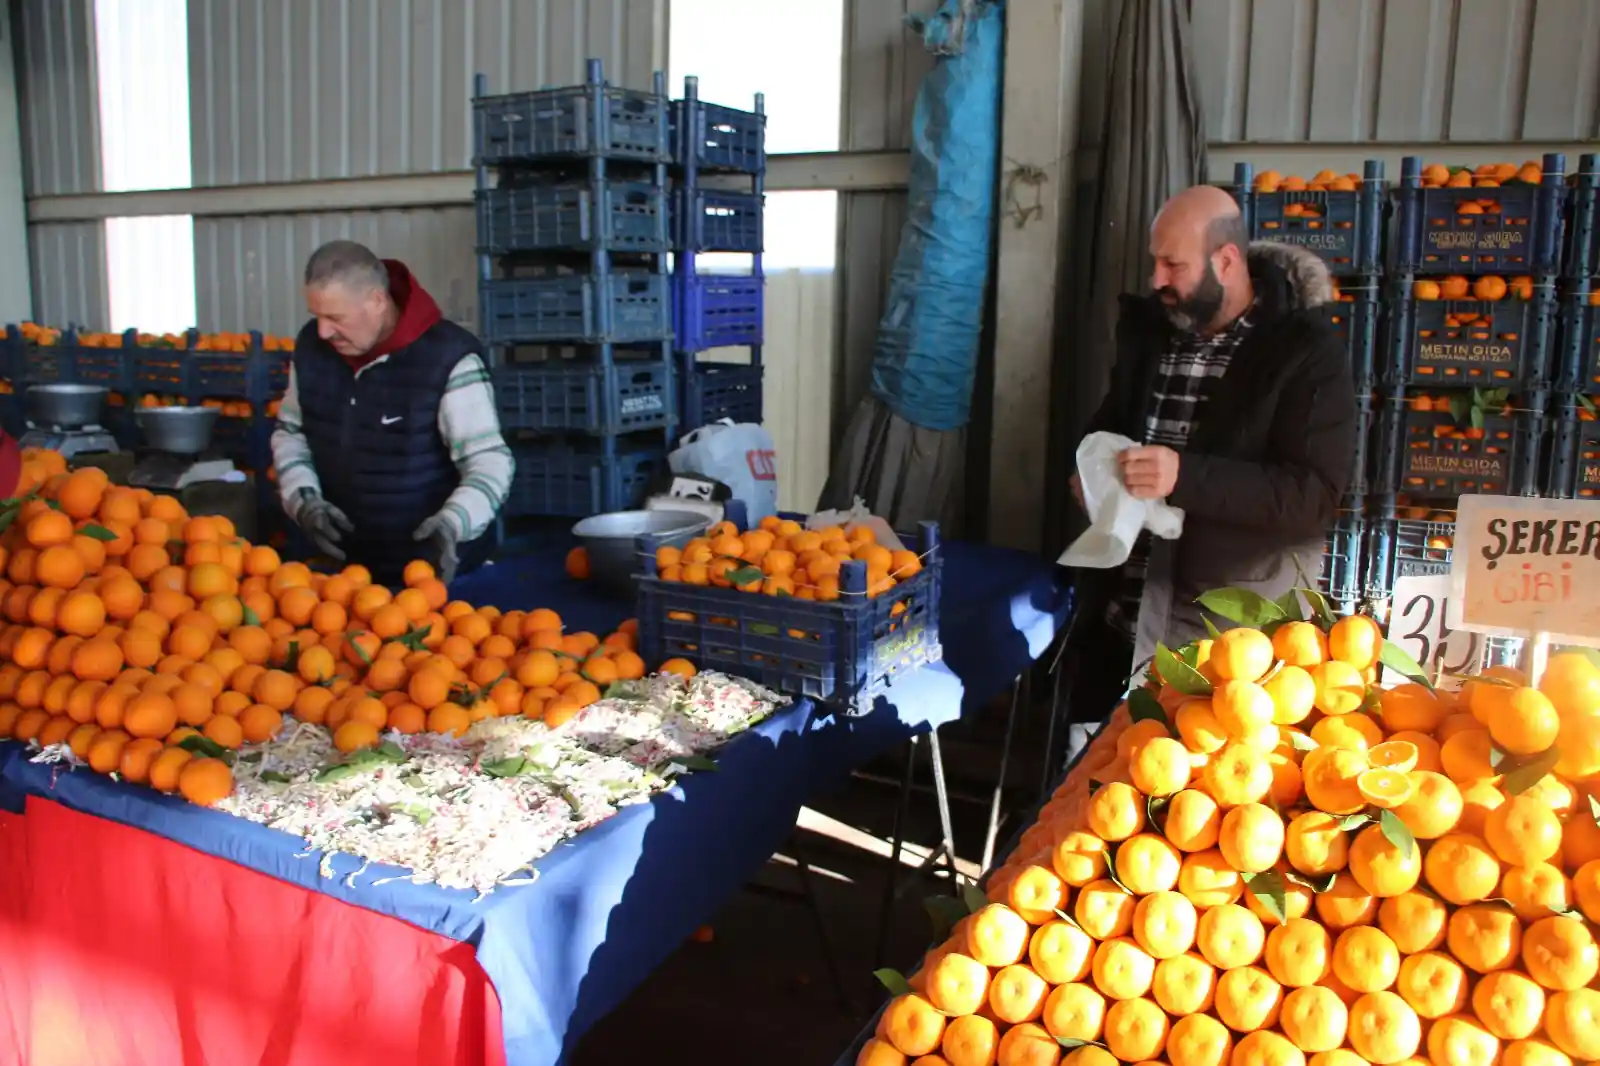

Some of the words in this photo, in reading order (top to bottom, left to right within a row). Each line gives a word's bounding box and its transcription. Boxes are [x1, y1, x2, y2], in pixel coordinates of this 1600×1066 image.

[1420, 343, 1469, 355] METIN
[1411, 455, 1459, 467] METIN
[1462, 458, 1501, 470] GIDA
[1481, 518, 1600, 570] ŞEKER
